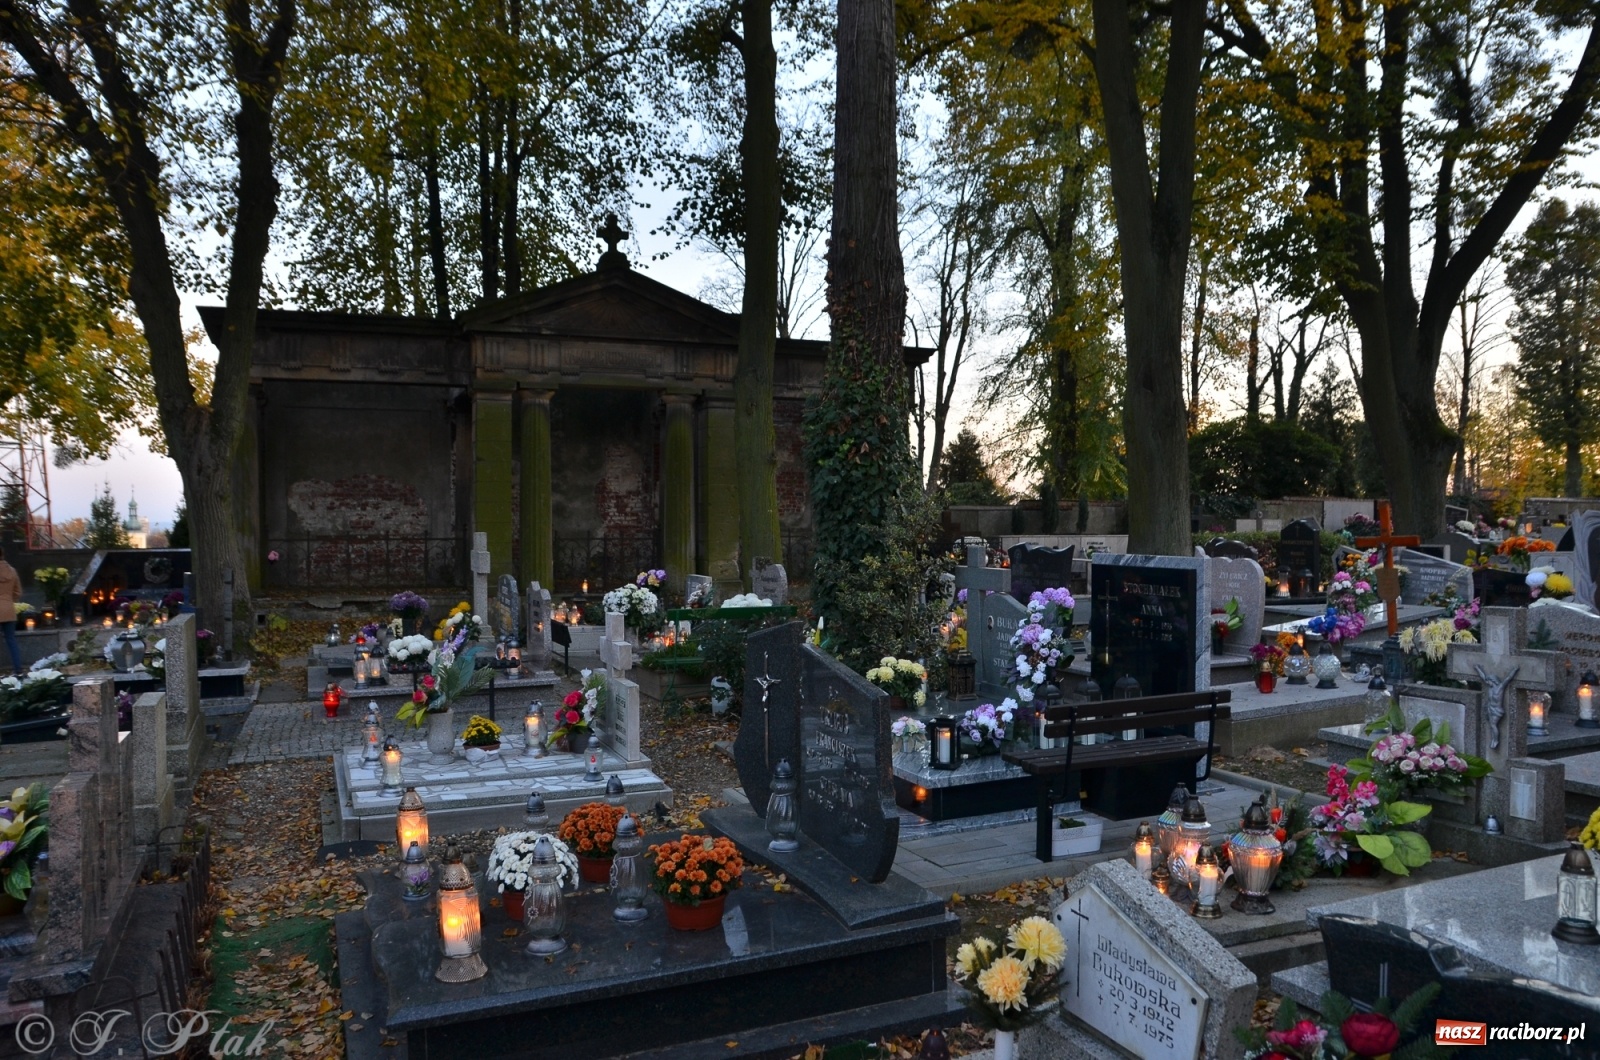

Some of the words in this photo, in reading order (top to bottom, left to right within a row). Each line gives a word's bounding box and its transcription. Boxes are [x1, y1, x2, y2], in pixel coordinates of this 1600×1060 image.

[1140, 604, 1163, 617] ANNA
[997, 617, 1018, 629] BURA
[1093, 952, 1191, 1019] Bukowska
